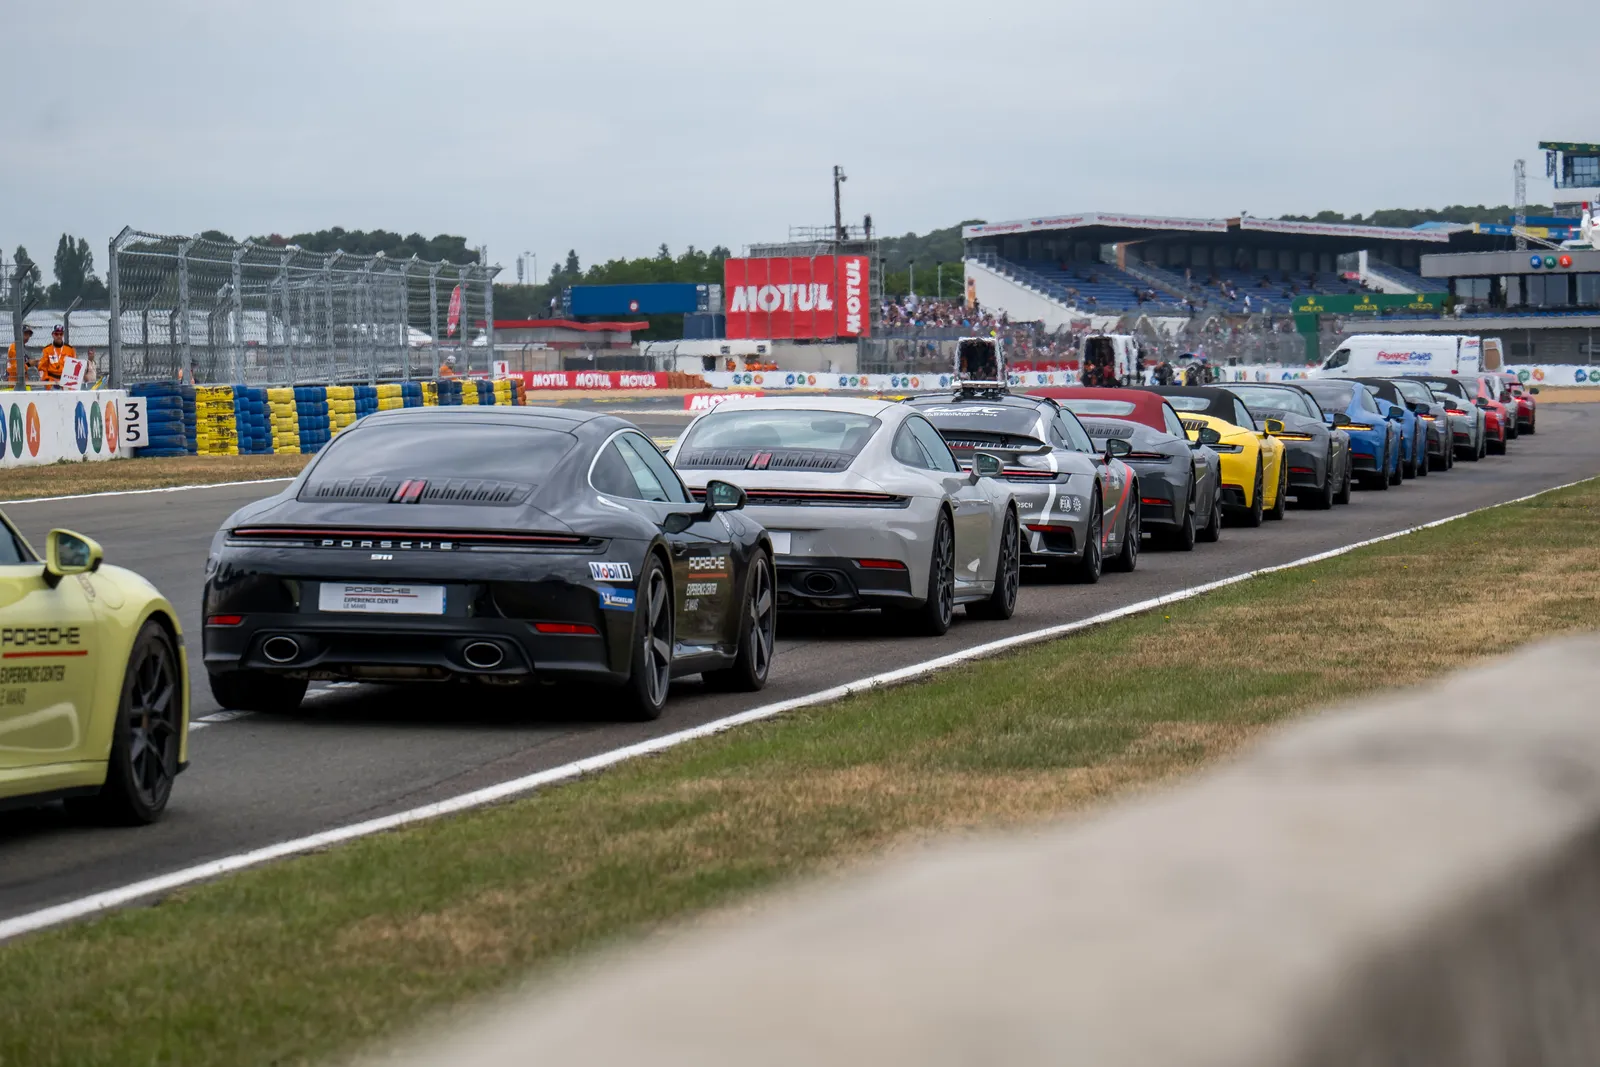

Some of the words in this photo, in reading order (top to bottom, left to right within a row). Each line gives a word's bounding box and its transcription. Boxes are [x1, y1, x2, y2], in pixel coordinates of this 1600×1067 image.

[730, 283, 834, 313] MOTUL
[846, 258, 861, 334] MOTUL
[533, 373, 568, 387] MOTUL
[575, 373, 612, 388] MOTUL
[1016, 501, 1033, 509] OSCH
[322, 539, 453, 550] PORSCHE
[689, 556, 725, 570] PORSCHE
[591, 563, 621, 579] Mobil
[344, 586, 411, 594] PORSCHE
[2, 627, 80, 646] PORSCHE
